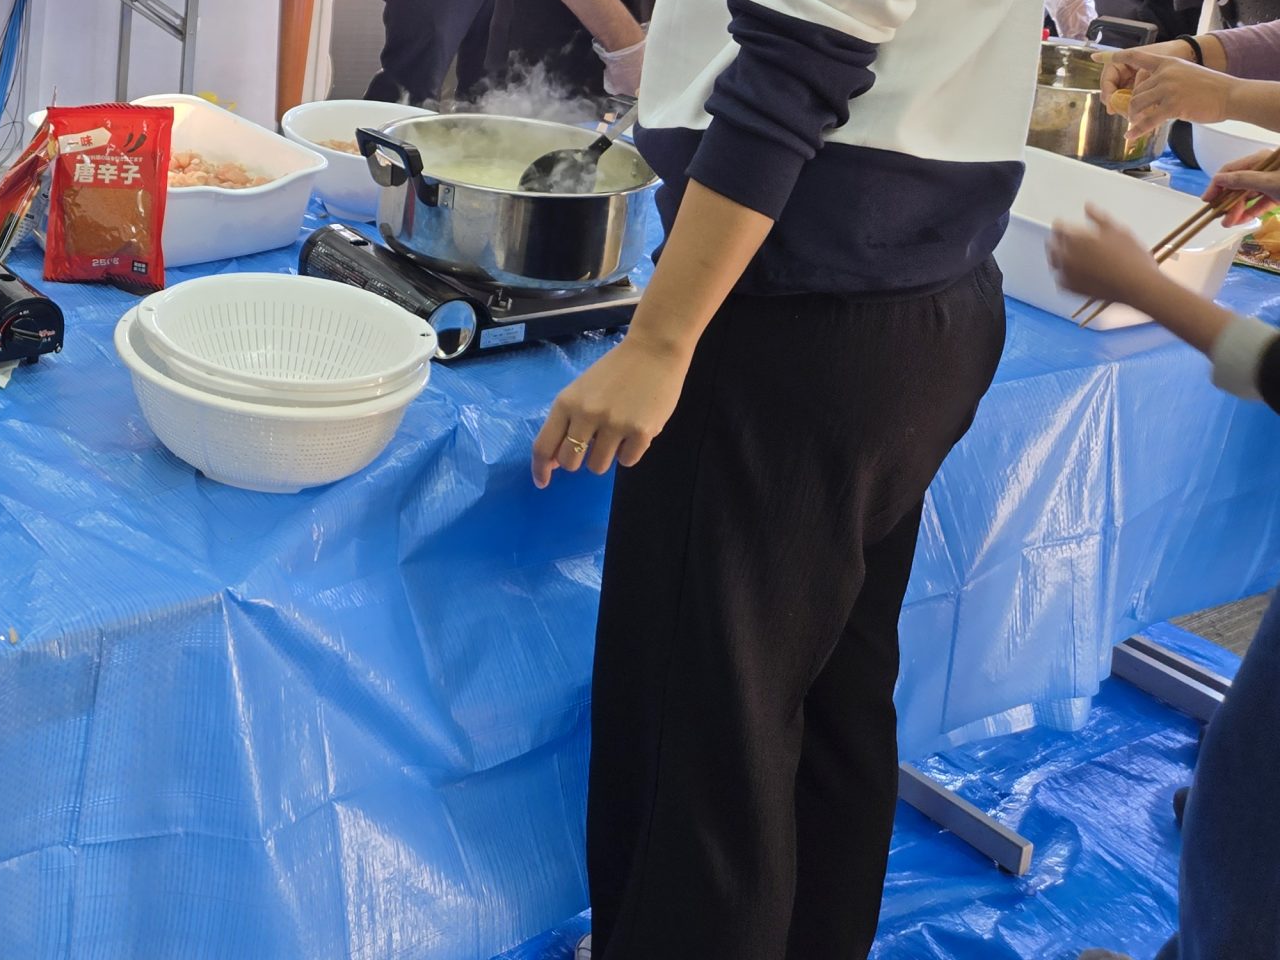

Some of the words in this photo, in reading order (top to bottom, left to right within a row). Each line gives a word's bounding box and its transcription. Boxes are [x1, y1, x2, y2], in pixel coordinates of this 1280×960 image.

[67, 135, 94, 148] 一味
[74, 163, 141, 184] 唐辛子
